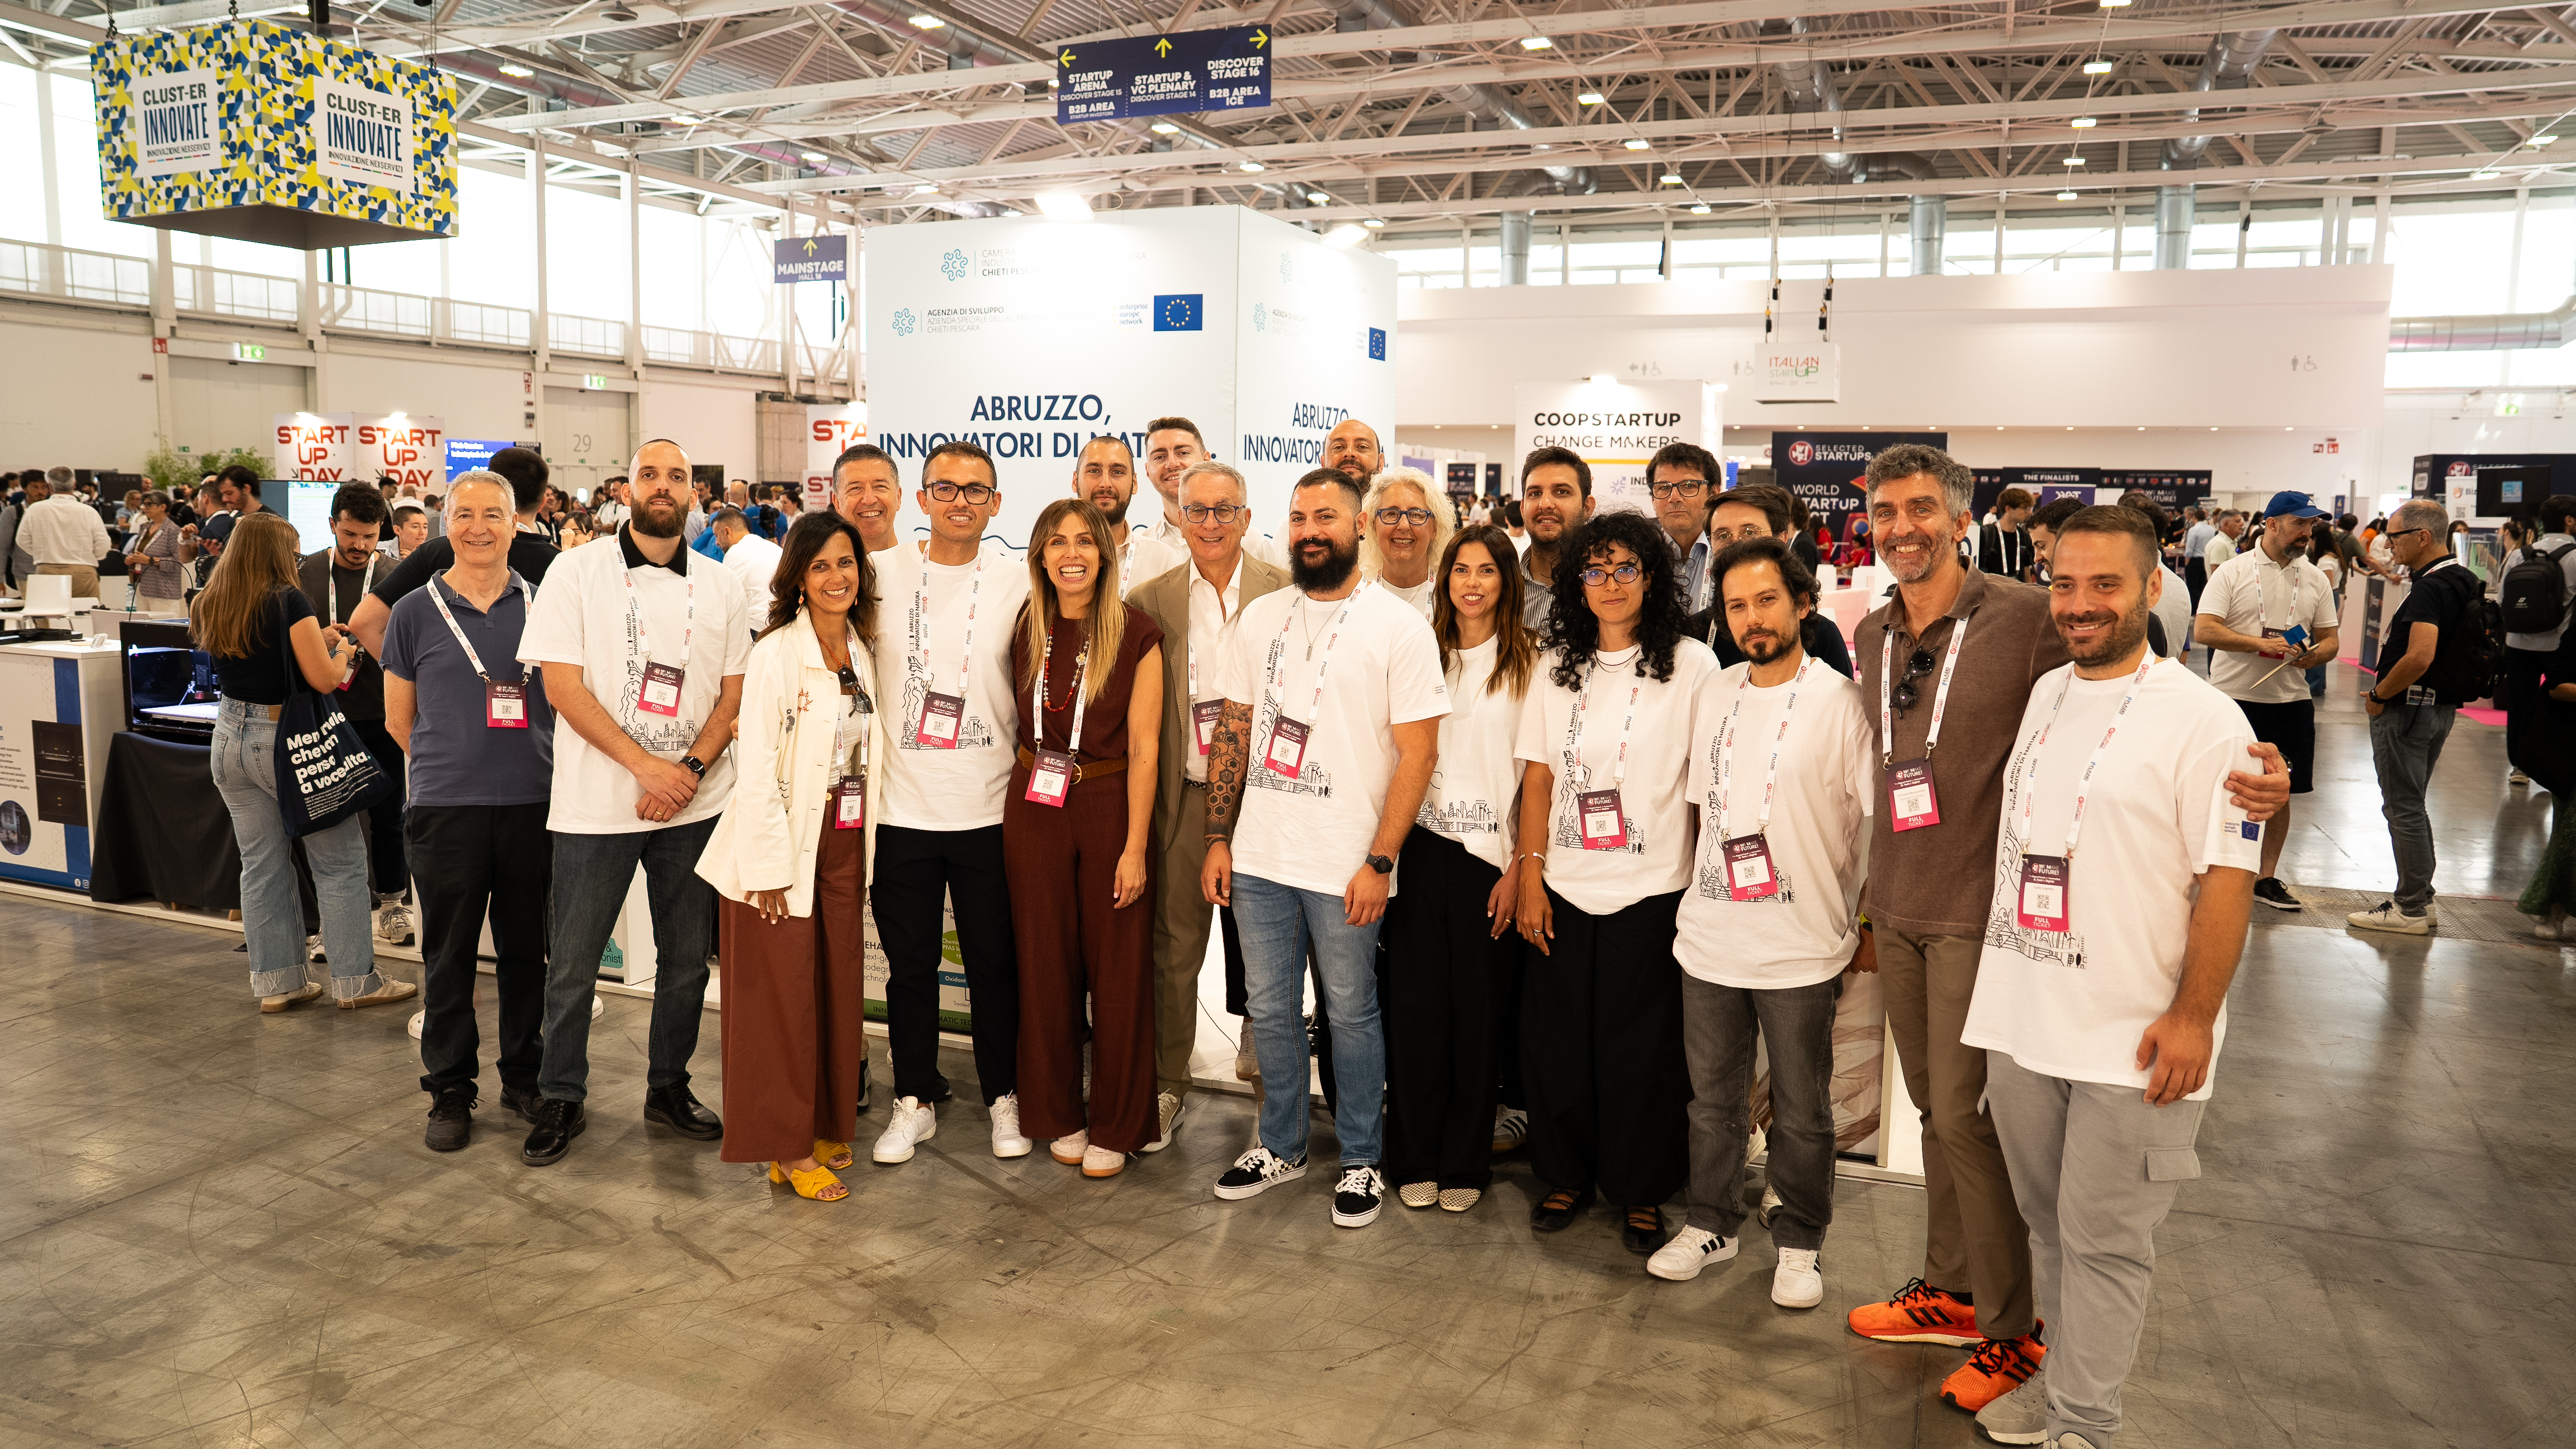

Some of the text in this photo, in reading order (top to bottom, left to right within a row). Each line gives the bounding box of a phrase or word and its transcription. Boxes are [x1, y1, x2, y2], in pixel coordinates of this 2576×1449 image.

[1207, 56, 1264, 70] DISCOVER
[1068, 70, 1113, 83] STARTUP
[1134, 71, 1192, 85] STARTUP &
[1210, 67, 1260, 80] STAGE 16
[1073, 80, 1108, 93] ARENA
[1130, 80, 1196, 95] VC PLENARY
[1209, 86, 1261, 99] B2B AREA
[143, 83, 207, 106] CLUST-ER
[1060, 92, 1093, 101] DISCOVER
[1093, 89, 1115, 98] STAGE
[1130, 93, 1165, 103] DISCOVER
[1166, 91, 1188, 100] STAGE
[1225, 96, 1244, 106] ICE
[326, 93, 401, 124] CLUST-ER
[1068, 101, 1115, 115] B2B AREA
[144, 102, 209, 145] INNOVATE
[327, 111, 402, 162] INNOVATE
[329, 150, 403, 173] INNOVAZIONE NEI SERVIZI
[982, 249, 1015, 258] CAMERA
[777, 260, 844, 275] MAINSTAGE
[982, 268, 1008, 277] CHIETI
[927, 306, 1005, 317] AGENZIA DI SVILUPPO
[1119, 302, 1148, 312] enterprise
[926, 316, 956, 325] AZIENDA
[956, 315, 988, 324] SPECIALE
[988, 314, 1010, 323] DELLA
[1119, 311, 1140, 319] europe
[926, 324, 981, 334] CHIETI PESCARA
[1769, 356, 1820, 367] ITALIAN
[970, 394, 1112, 425] ABRUZZO,
[1534, 413, 1681, 427] COOPSTARTUP
[277, 425, 350, 444] START
[358, 426, 442, 447] START
[1533, 435, 1603, 448] CHANGE
[572, 433, 593, 453] 29
[1053, 432, 1078, 458] DI
[1244, 434, 1325, 465] INNOVATOR
[298, 442, 328, 465] UP
[383, 443, 418, 466] UP
[1815, 451, 1872, 461] STARTUPS
[300, 468, 343, 481] DAY
[386, 468, 434, 487] DAY
[1631, 476, 1647, 485] IND
[1793, 484, 1840, 495] WORLD
[1801, 498, 1859, 510] TARTUP
[1267, 639, 1277, 664] ABRUZZO
[1269, 650, 1278, 684] INNOVATORI
[1569, 703, 1578, 727] ABRUZZO
[1718, 716, 1729, 740] NATURA
[1903, 770, 1923, 779] FUTURE!
[2009, 751, 2023, 784] ABRUZZO
[2011, 764, 2023, 811] INNOVATORI
[2023, 730, 2040, 755] NATURA
[300, 782, 314, 794] a
[313, 767, 347, 789] voce
[606, 943, 613, 953] &
